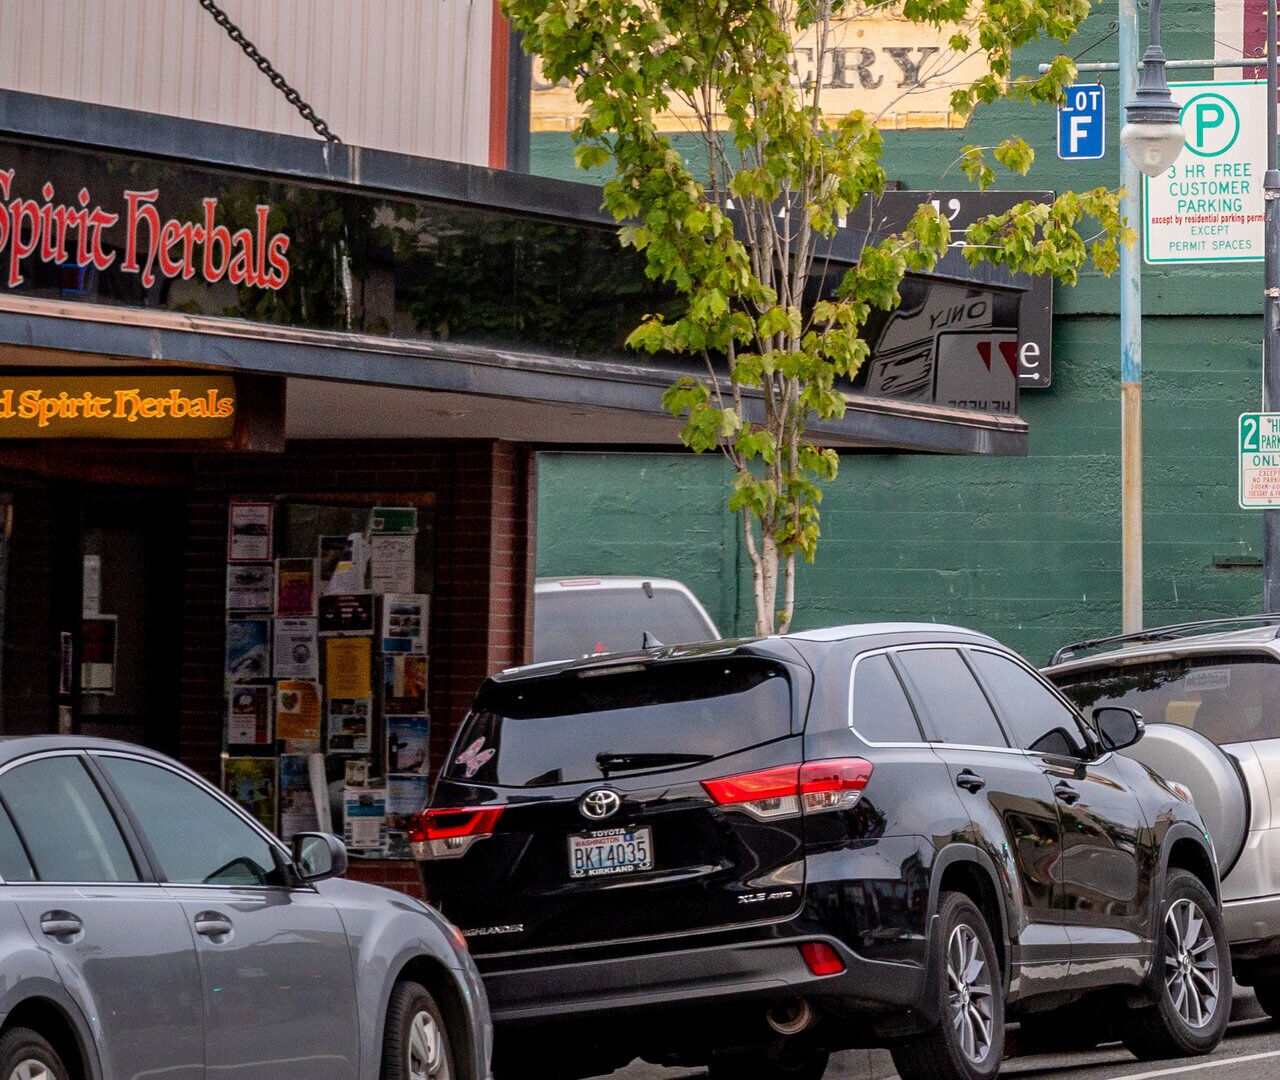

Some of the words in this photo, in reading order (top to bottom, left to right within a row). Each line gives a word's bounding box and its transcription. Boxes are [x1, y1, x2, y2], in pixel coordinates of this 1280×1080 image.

[1063, 91, 1101, 112] LOT
[1070, 116, 1092, 152] F
[1185, 164, 1205, 178] HR
[1214, 163, 1252, 177] FREE
[1169, 181, 1250, 196] CUSTOMER
[1177, 198, 1242, 213] PARKING
[1152, 216, 1172, 225] except
[1174, 215, 1183, 226] by
[1184, 214, 1219, 224] residential
[1221, 214, 1245, 225] parking
[1247, 213, 1267, 224] permi
[1191, 225, 1230, 236] EXCEPT
[121, 188, 291, 290] Herbals
[1169, 241, 1206, 251] PERMIT
[1212, 239, 1252, 250] SPACES
[18, 389, 112, 427] Spirit
[113, 388, 235, 422] Herbals
[1243, 418, 1257, 450] 2
[591, 828, 626, 838] TOYOTA
[575, 836, 620, 848] WASHINGTON
[574, 840, 647, 870] BKT4035
[588, 864, 634, 876] KIRKLAND
[737, 892, 766, 904] XLE
[462, 924, 524, 937] IGHLANDER
